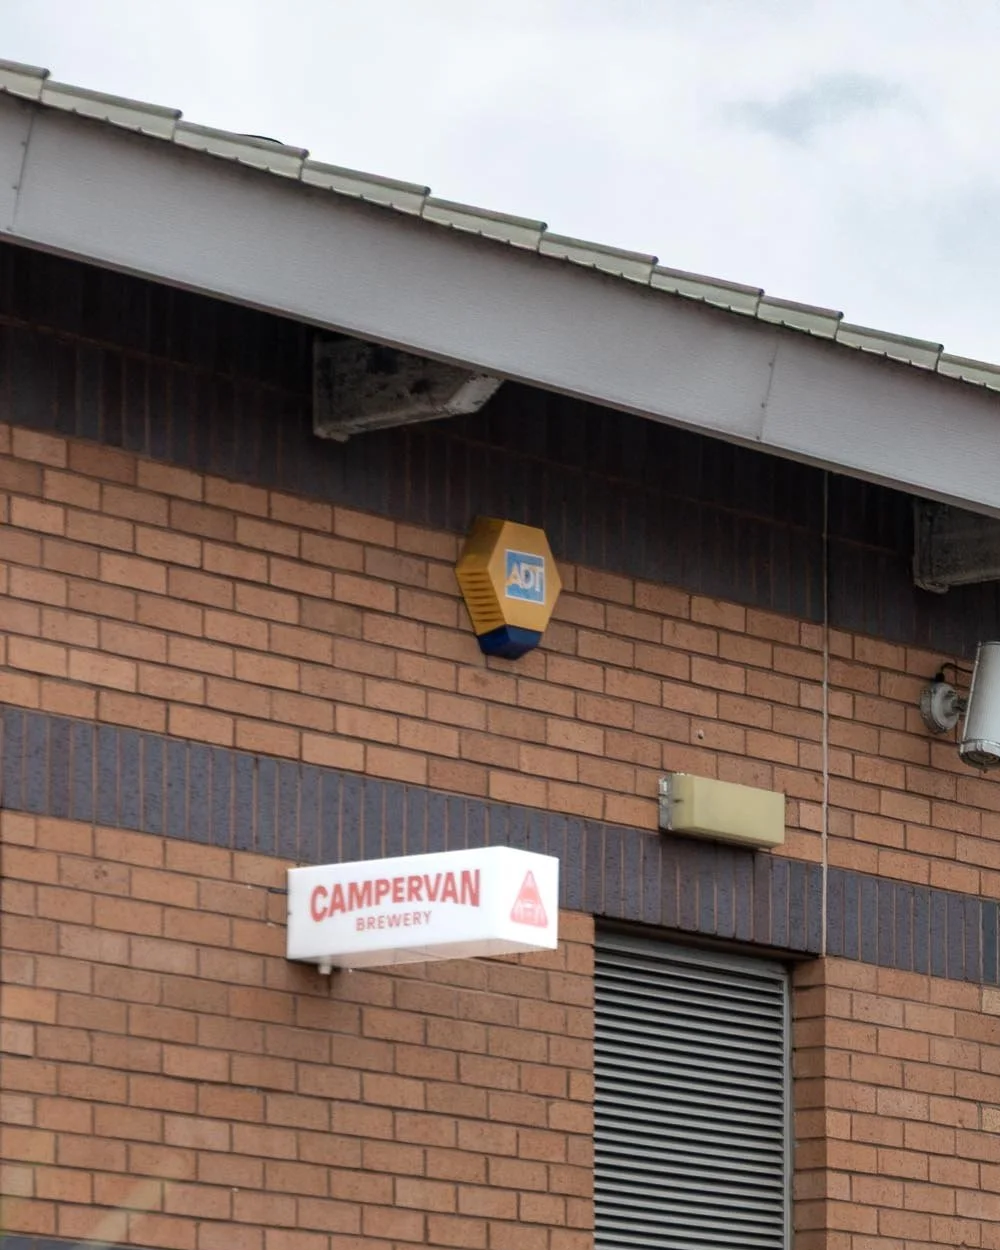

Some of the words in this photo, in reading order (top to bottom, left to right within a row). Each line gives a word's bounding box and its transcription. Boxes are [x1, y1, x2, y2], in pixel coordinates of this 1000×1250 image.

[504, 562, 545, 593] ADT
[309, 869, 481, 923] CAMPERVAN
[356, 910, 433, 932] BREWERY
